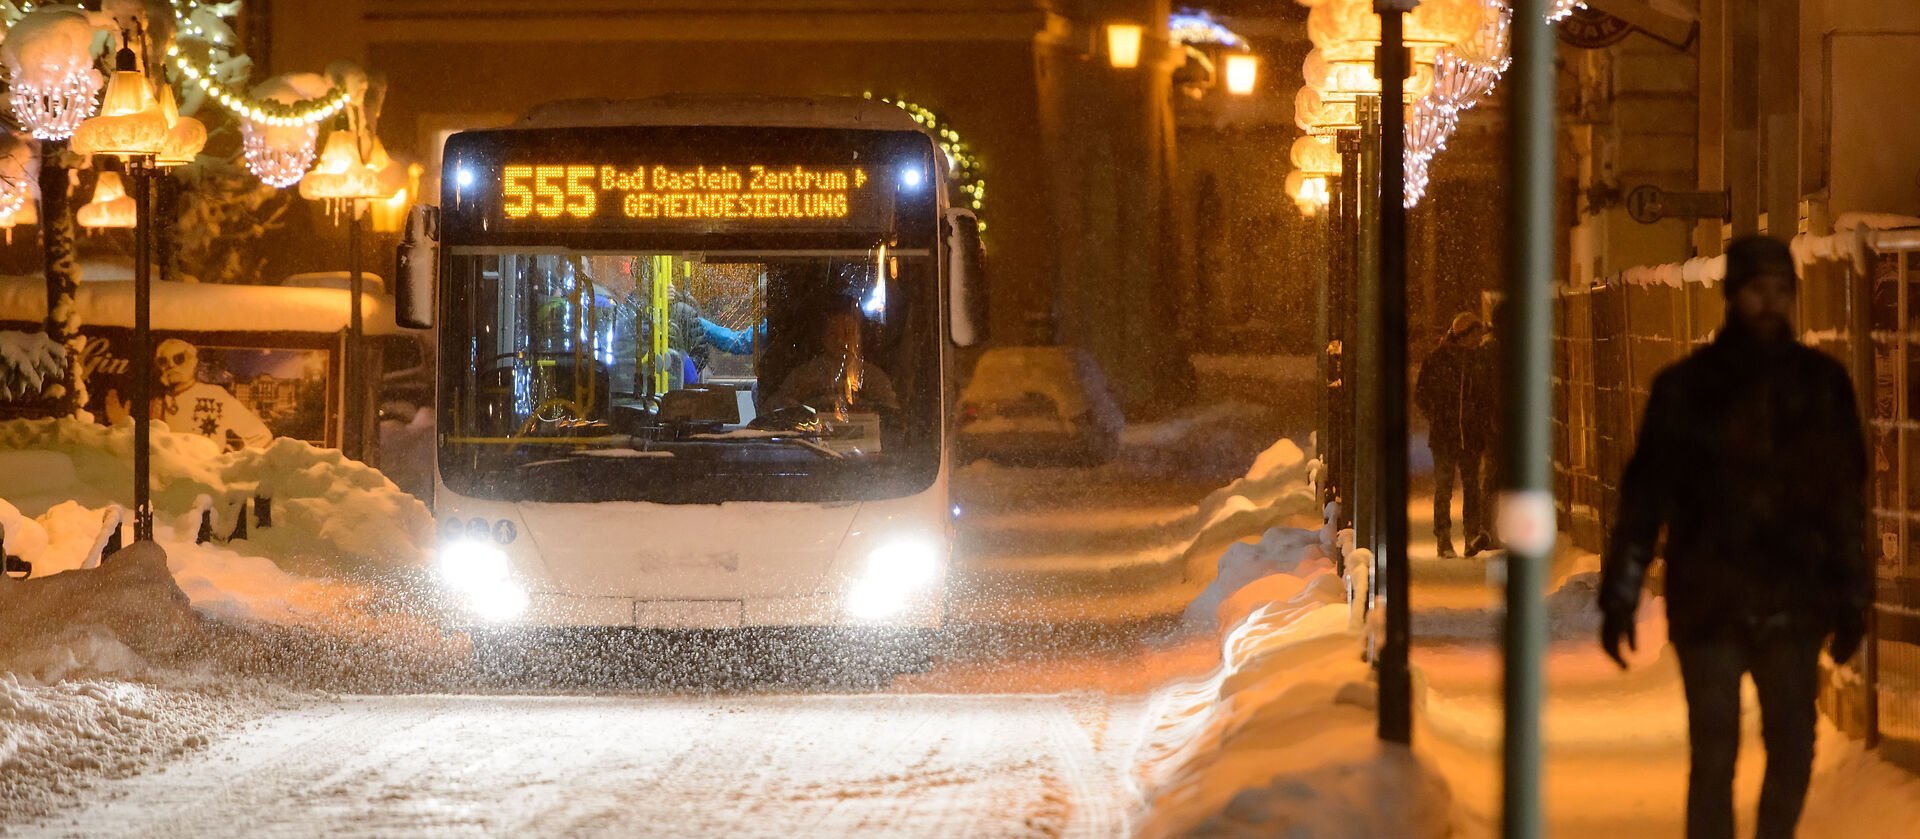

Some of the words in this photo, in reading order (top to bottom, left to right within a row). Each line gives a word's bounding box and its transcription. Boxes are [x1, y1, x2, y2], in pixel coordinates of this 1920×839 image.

[504, 166, 596, 217] 555
[601, 165, 645, 190] Bad
[653, 165, 741, 190] Gastein
[750, 166, 848, 190] Zentrum
[624, 194, 848, 218] GEMEINDESIEDLUNG
[80, 337, 129, 380] Gin
